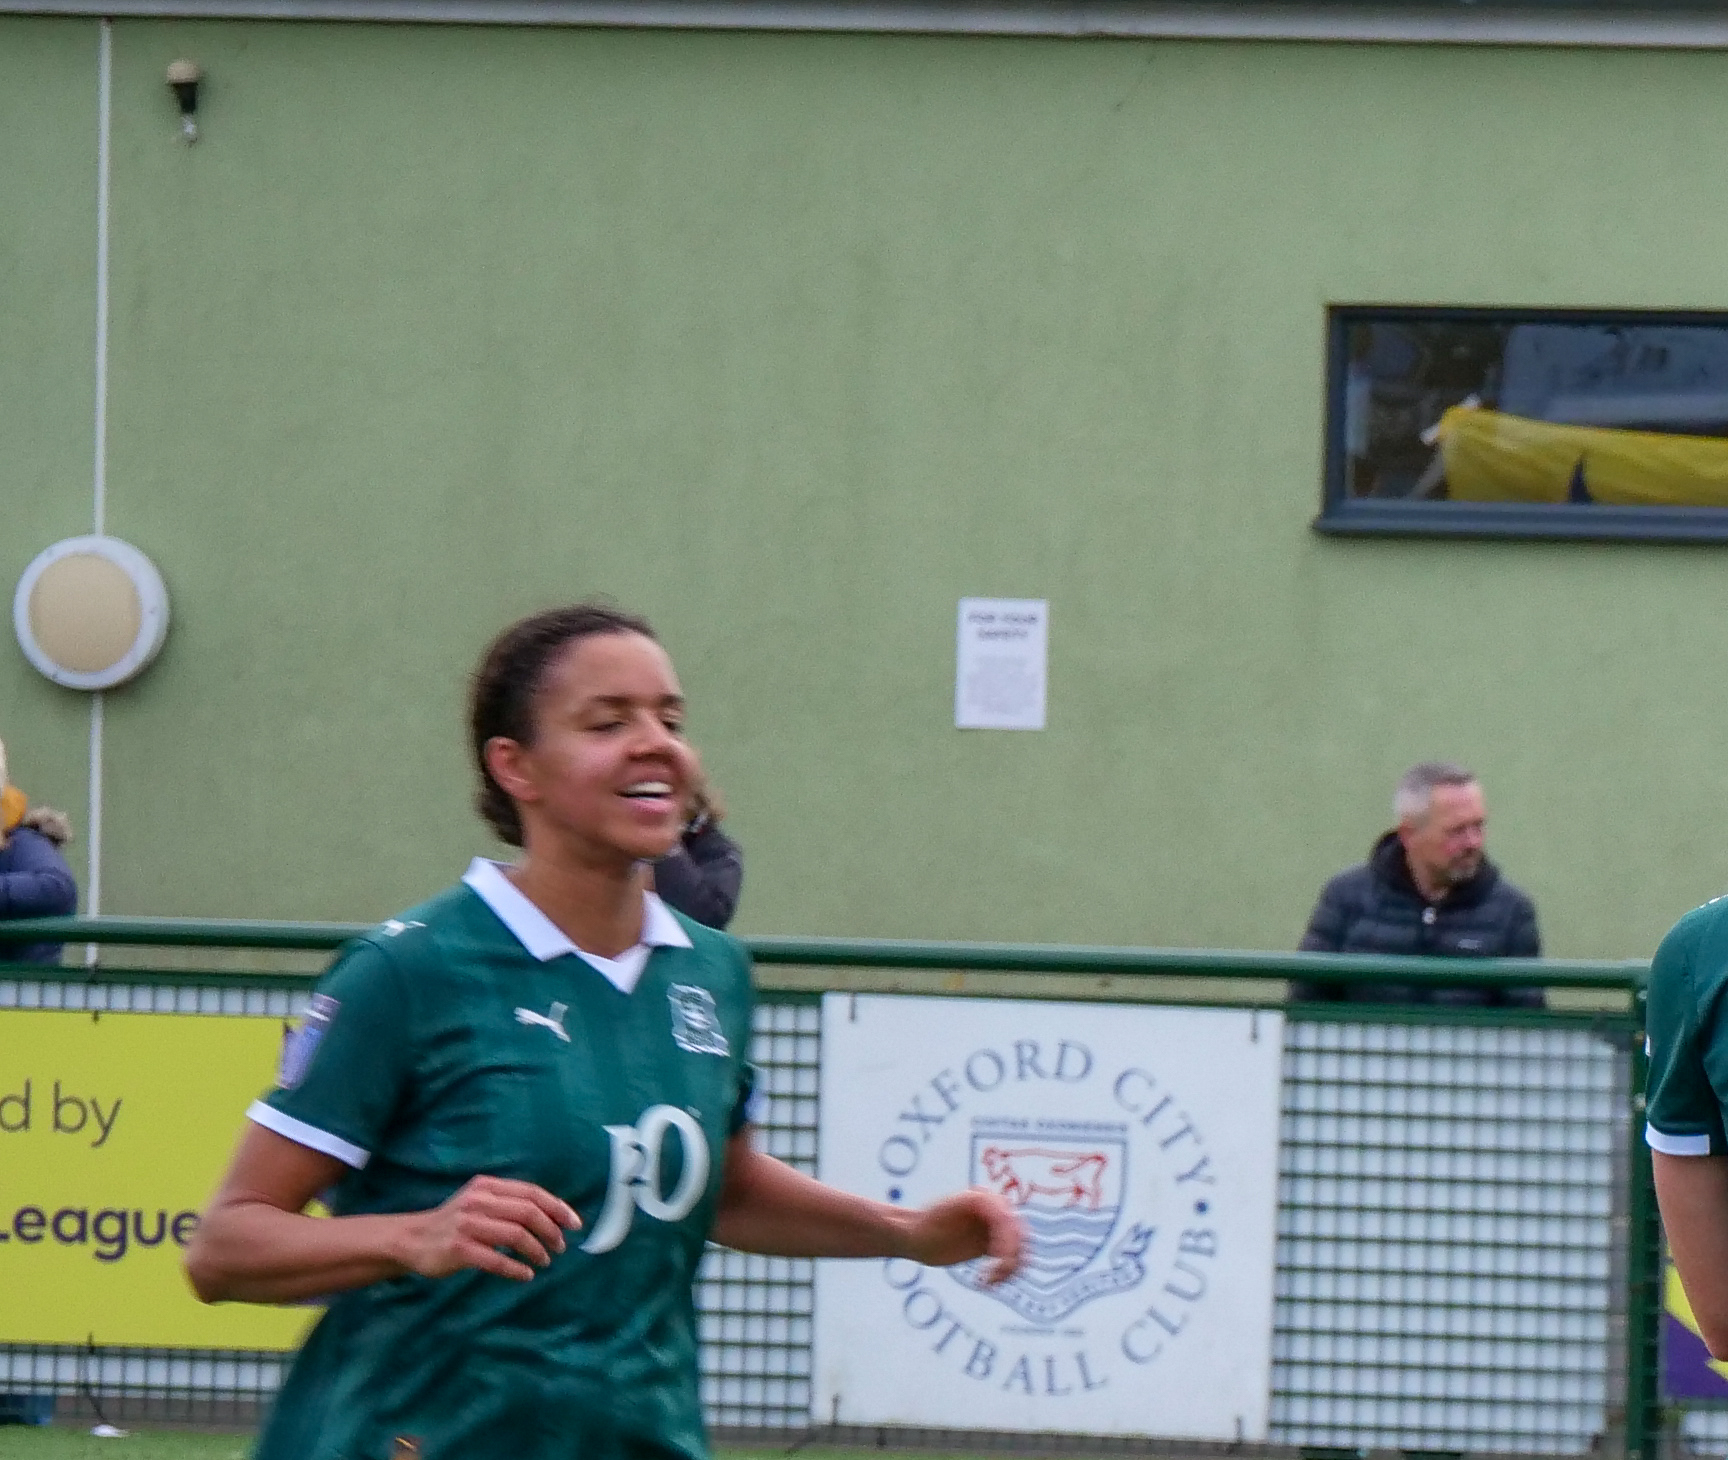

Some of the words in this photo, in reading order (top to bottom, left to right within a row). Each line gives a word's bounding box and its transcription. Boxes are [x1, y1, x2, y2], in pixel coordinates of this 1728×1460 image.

[53, 1079, 123, 1148] by
[878, 1038, 1094, 1178] OXFORD
[1112, 1066, 1216, 1187] CITY
[0, 1205, 202, 1264] eague
[883, 1256, 1108, 1397] OOTBALL
[1120, 1228, 1217, 1365] CLUB
